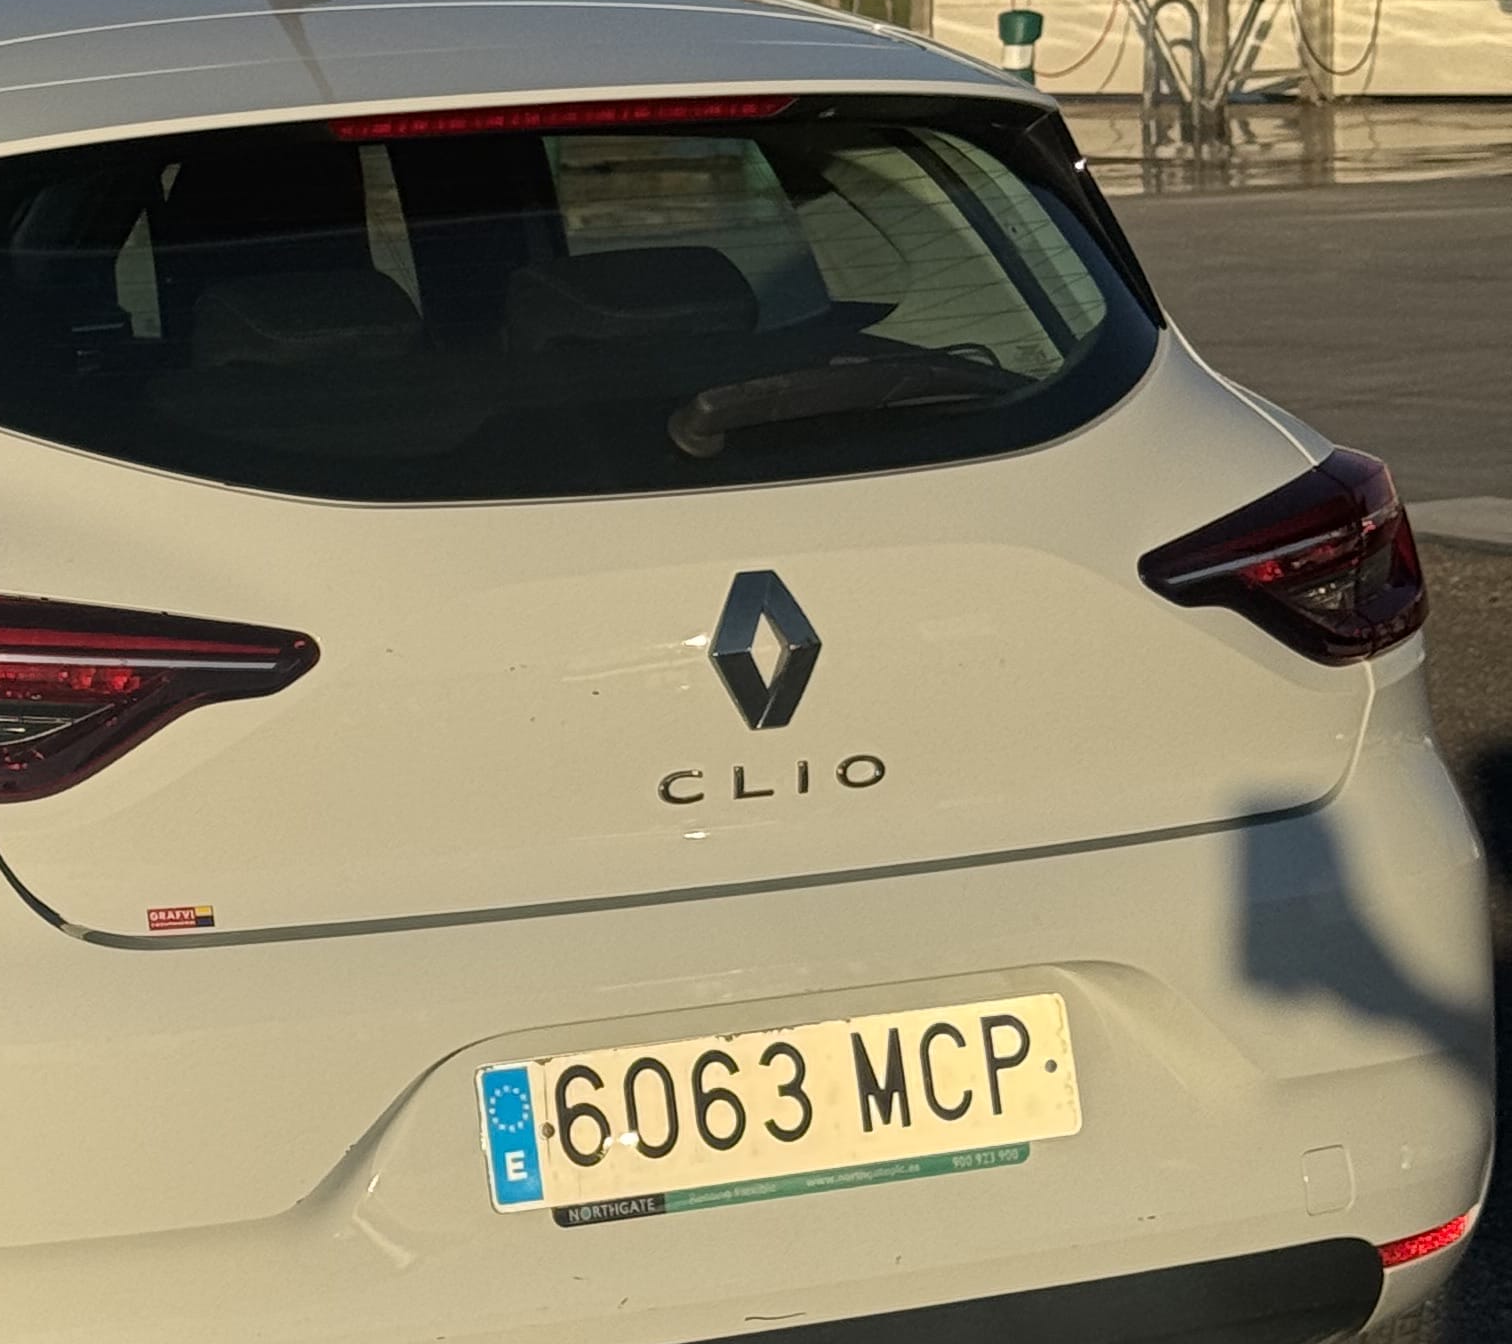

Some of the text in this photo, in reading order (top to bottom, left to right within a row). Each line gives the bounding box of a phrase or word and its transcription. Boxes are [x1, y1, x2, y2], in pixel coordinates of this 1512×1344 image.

[657, 754, 886, 805] CLIO
[554, 1014, 1031, 1167] 6063 MCP
[504, 1150, 528, 1182] E
[568, 1198, 656, 1223] NORTHGATE
